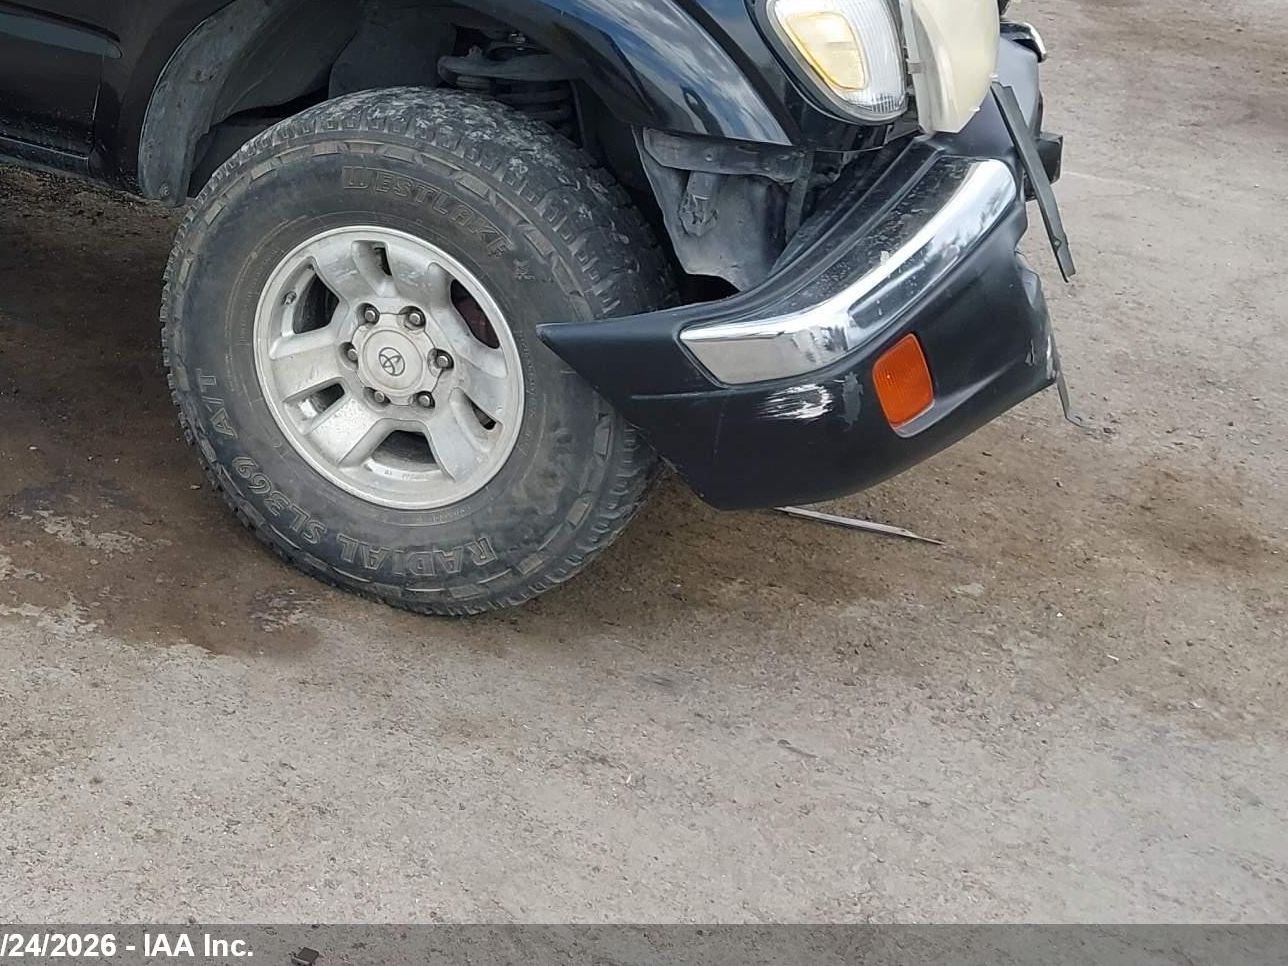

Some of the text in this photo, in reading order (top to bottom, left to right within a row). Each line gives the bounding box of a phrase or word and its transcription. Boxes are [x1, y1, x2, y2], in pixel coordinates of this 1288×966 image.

[196, 368, 497, 577] RADIAL SL369 A/T
